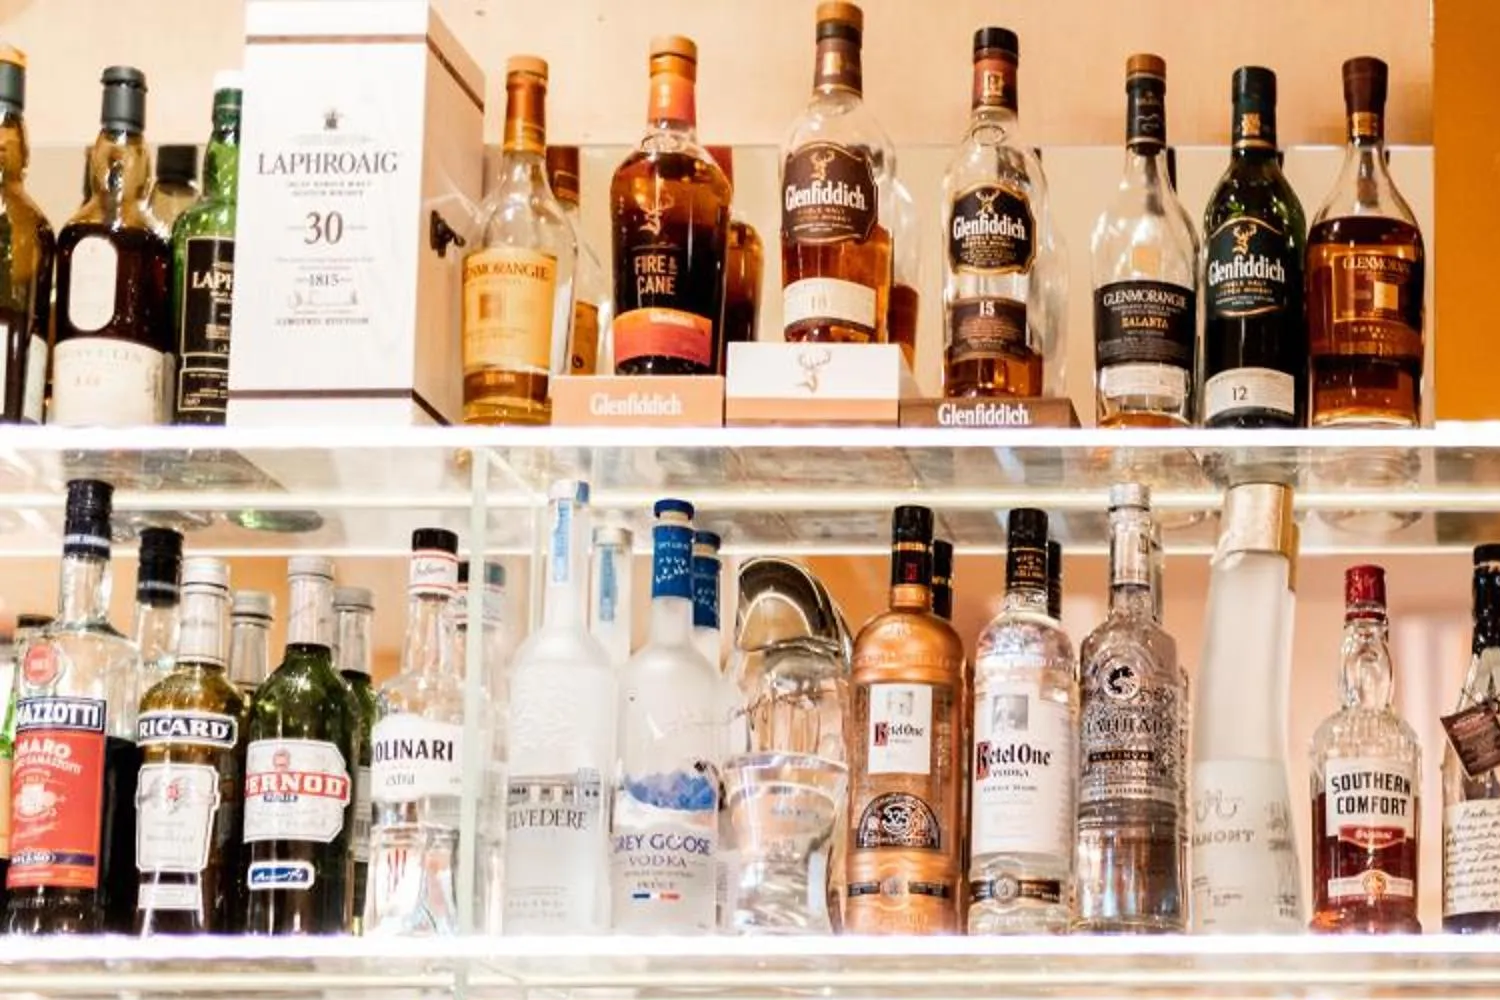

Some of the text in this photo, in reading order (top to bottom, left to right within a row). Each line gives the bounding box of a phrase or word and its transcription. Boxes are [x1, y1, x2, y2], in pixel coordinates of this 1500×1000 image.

[257, 152, 398, 175] LAPHROAIG
[785, 179, 866, 212] Glenfiddich
[304, 210, 344, 245] 30
[953, 213, 1026, 240] Glenfiddich
[634, 255, 667, 275] FIRE
[1208, 253, 1285, 286] Glenfiddich
[309, 274, 339, 286] 1815
[636, 275, 676, 296] CANE
[980, 300, 995, 317] 15
[590, 393, 683, 417] Glenfiddich
[1231, 386, 1248, 401] 12
[938, 403, 1031, 427] Glenfiddich
[139, 715, 230, 741] RICARD
[976, 741, 1051, 780] Ketel One
[1331, 772, 1412, 796] SOUTHERN
[1336, 796, 1408, 817] COMFORT
[506, 808, 587, 831] ELVEDERE
[649, 833, 711, 856] GOOSE
[628, 855, 687, 868] VODKA
